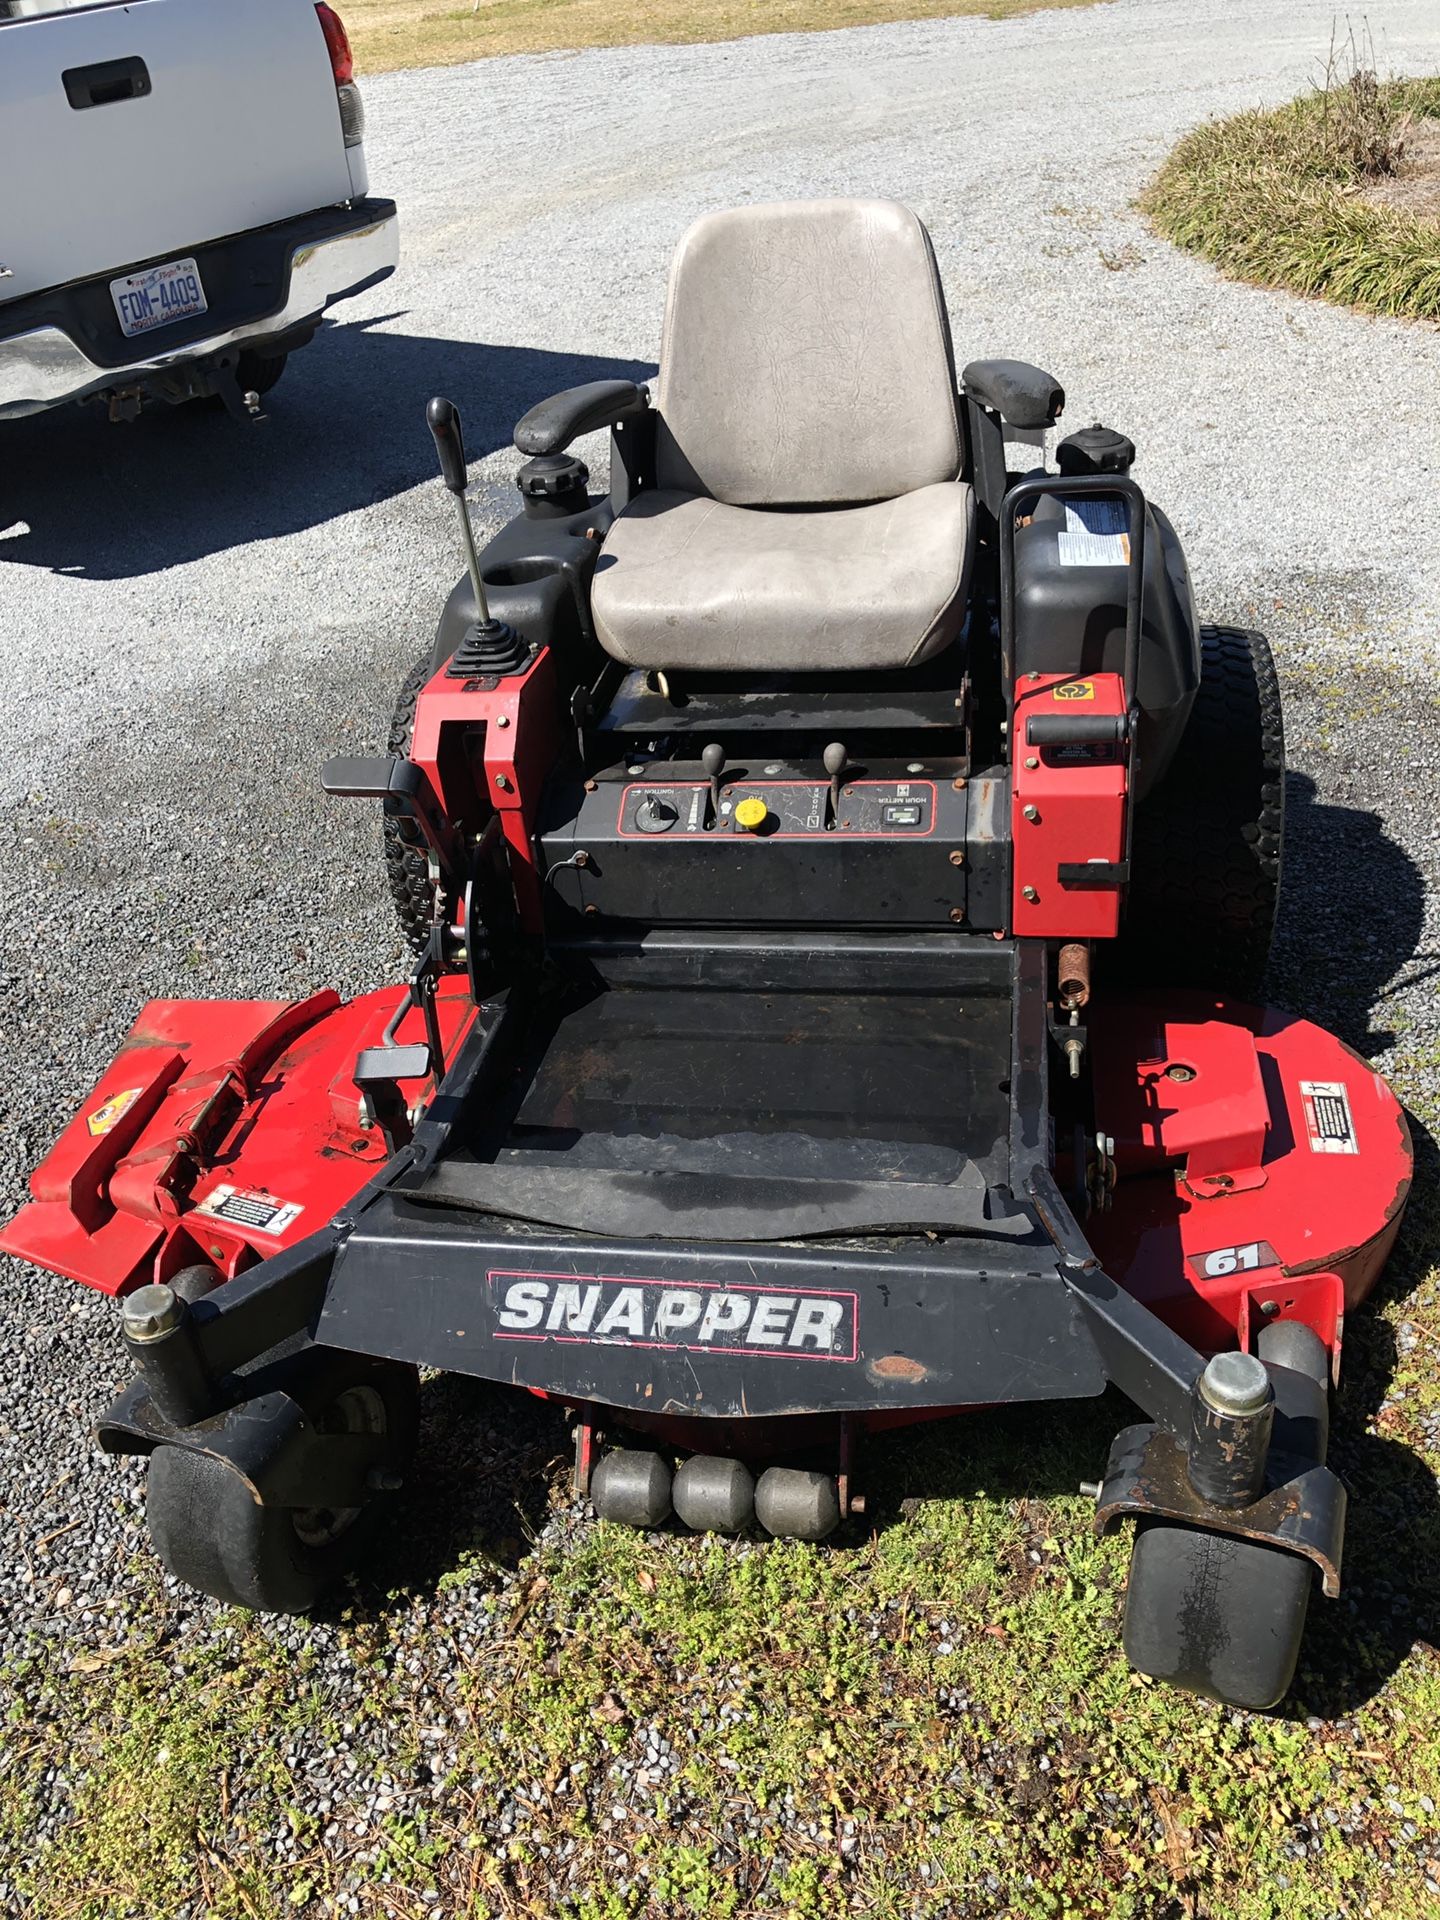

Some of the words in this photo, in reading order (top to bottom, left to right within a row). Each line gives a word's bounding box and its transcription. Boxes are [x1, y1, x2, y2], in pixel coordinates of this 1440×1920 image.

[118, 275, 200, 323] FDM-4409
[130, 315, 158, 330] NORTH
[160, 303, 199, 321] CAROLINA
[1205, 1243, 1259, 1276] 61
[499, 1281, 845, 1349] SNAPPER
